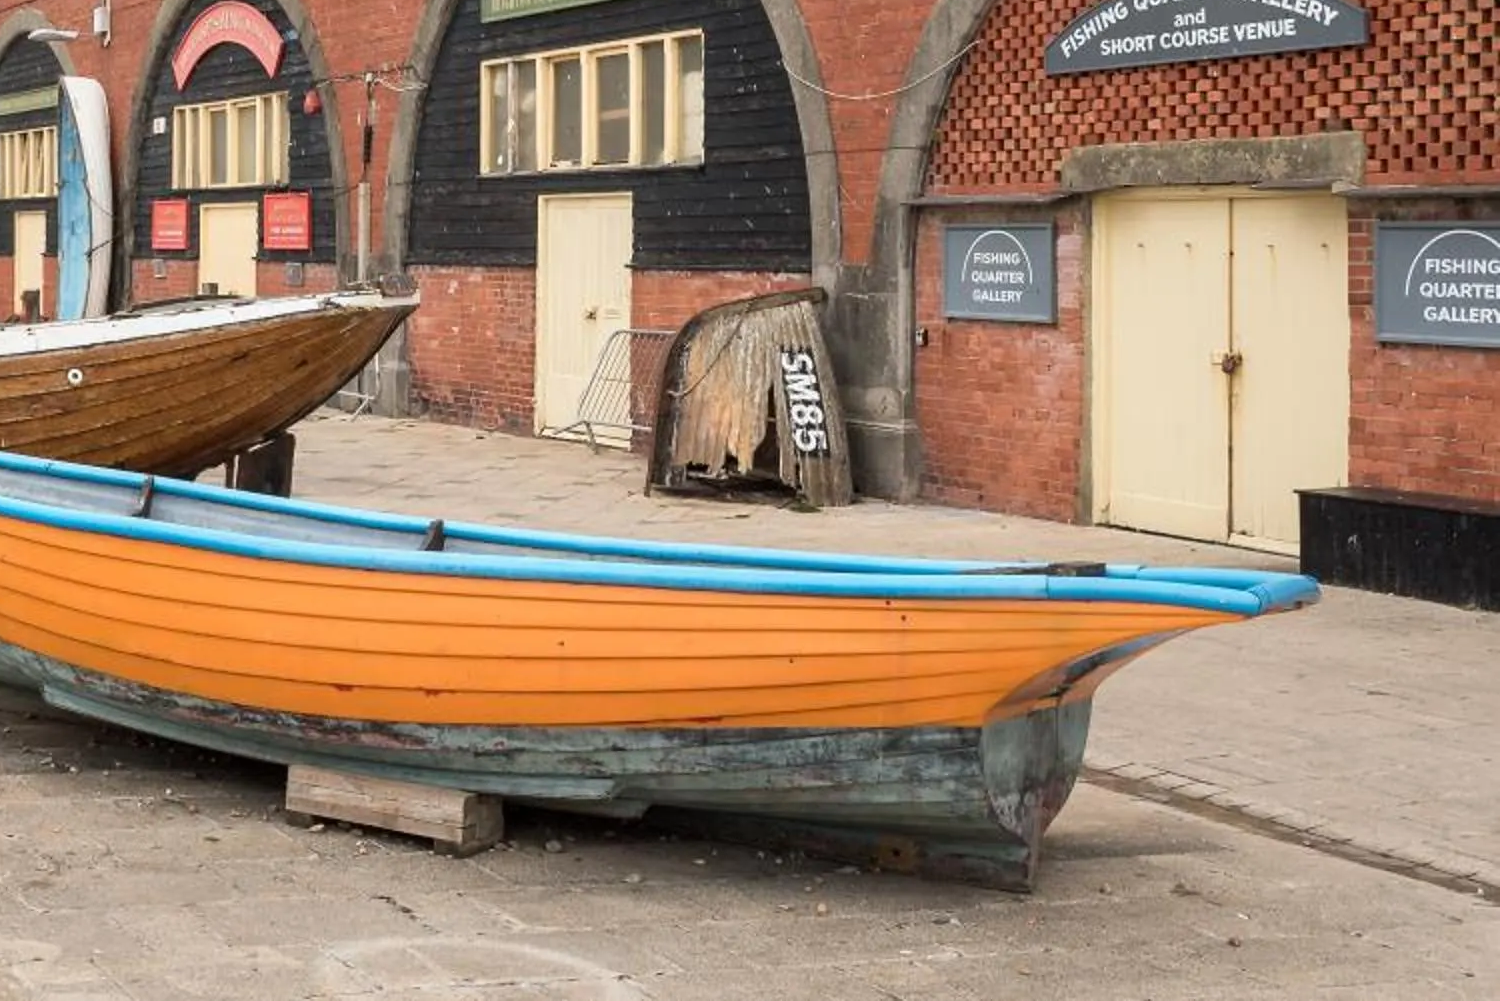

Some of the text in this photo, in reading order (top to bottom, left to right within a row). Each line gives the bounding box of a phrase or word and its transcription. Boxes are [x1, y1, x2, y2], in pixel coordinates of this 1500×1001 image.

[1173, 8, 1207, 27] and
[1060, 1, 1129, 59] FISHING
[1100, 18, 1297, 56] SHORT COURSE VENUE
[973, 252, 1021, 266] FISHING
[1424, 258, 1500, 274] FISHING
[971, 270, 1025, 284] QUARTER
[972, 289, 1023, 303] GALLERY
[1423, 306, 1500, 324] GALLERY
[781, 352, 828, 452] SM85
